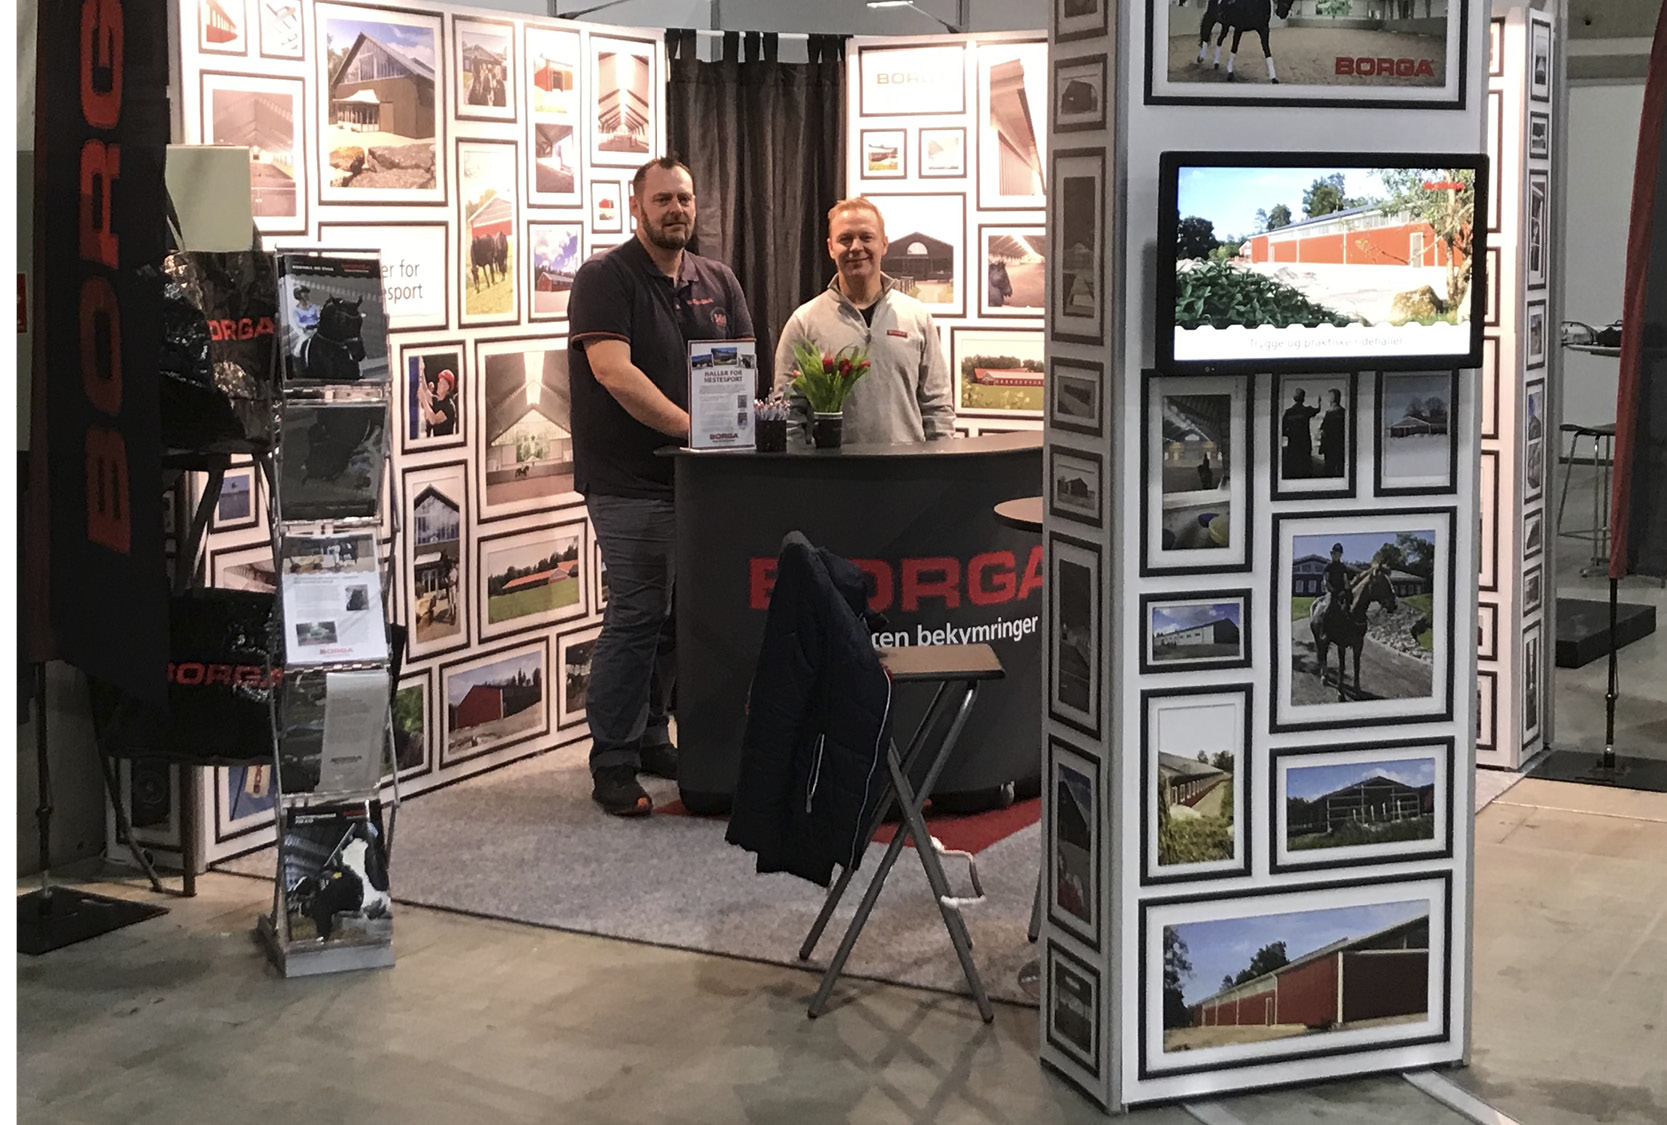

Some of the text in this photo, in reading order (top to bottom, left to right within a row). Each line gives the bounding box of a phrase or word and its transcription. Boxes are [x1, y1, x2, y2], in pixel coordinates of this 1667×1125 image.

[1335, 57, 1435, 77] BORGA
[400, 258, 421, 278] for
[917, 615, 1039, 646] bekymringer
